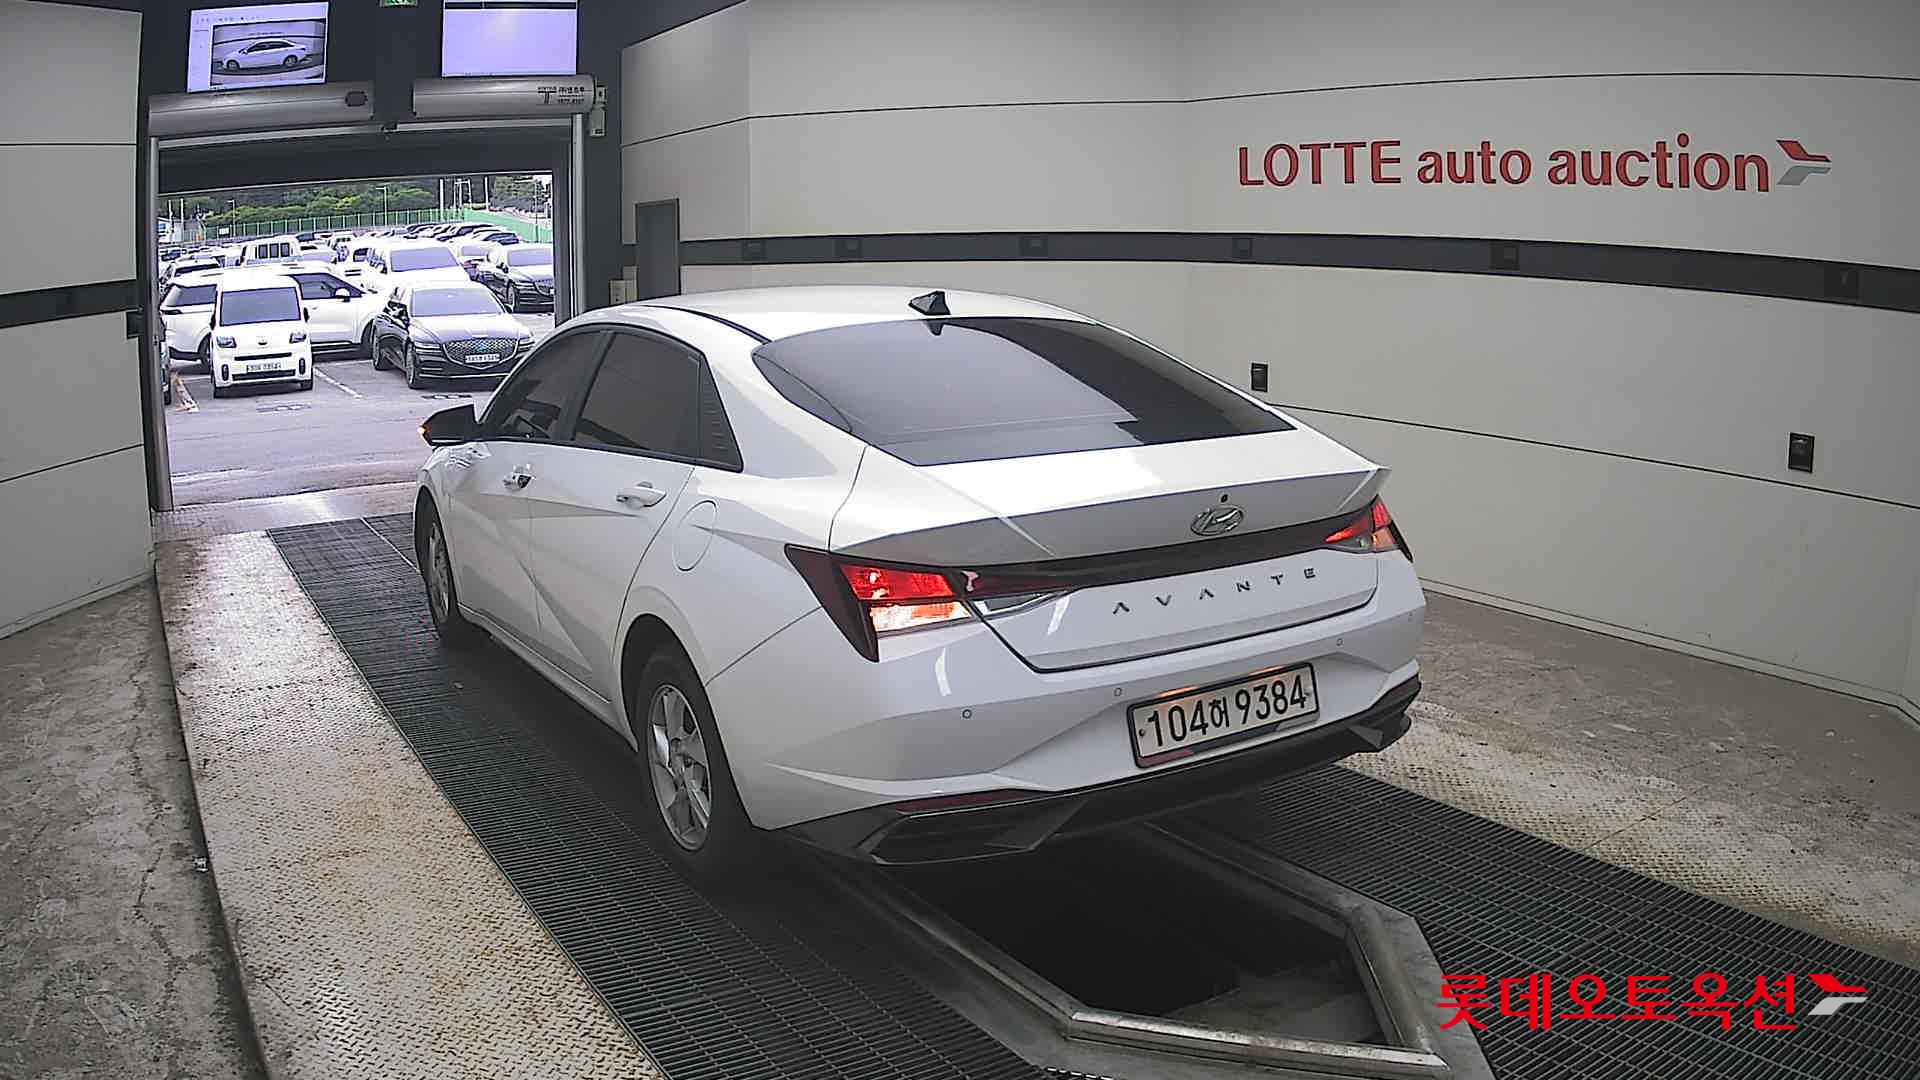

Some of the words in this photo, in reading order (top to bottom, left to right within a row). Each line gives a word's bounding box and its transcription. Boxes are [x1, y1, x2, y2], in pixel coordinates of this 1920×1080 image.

[1238, 140, 1401, 187] LOTTE
[1416, 141, 1533, 185] auto
[1547, 133, 1770, 192] auction
[1112, 567, 1316, 615] AVANTE
